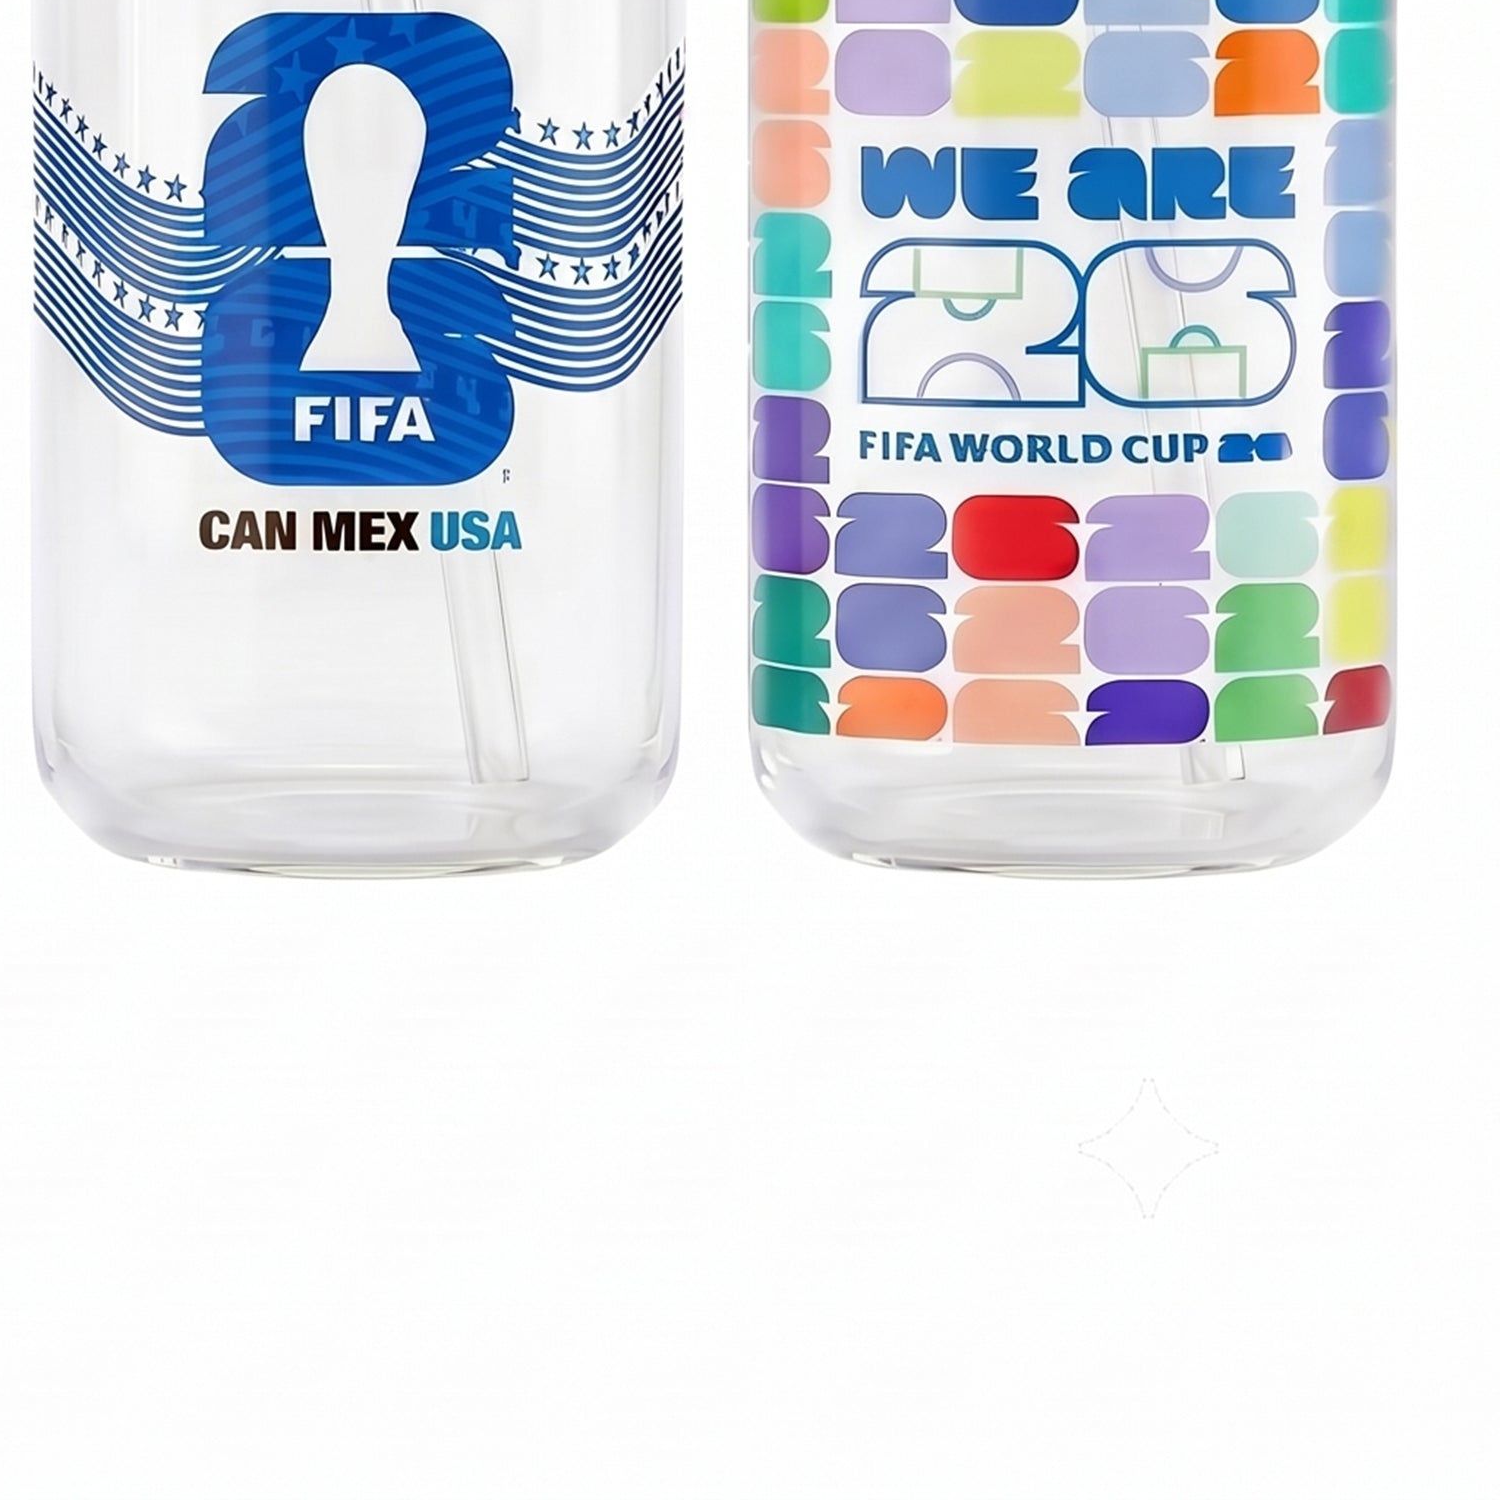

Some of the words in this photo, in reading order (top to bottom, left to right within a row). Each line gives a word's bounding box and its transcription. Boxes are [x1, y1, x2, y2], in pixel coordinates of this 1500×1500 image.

[861, 145, 1040, 221] WE
[1066, 146, 1297, 222] ARE
[859, 237, 1298, 410] 26
[293, 396, 436, 443] FIFA
[858, 430, 943, 463] FIFA
[948, 431, 1113, 465] WORLD
[1121, 432, 1209, 465] CUP
[198, 509, 297, 551] CAN
[312, 510, 420, 552] MEX
[430, 510, 523, 552] USA
